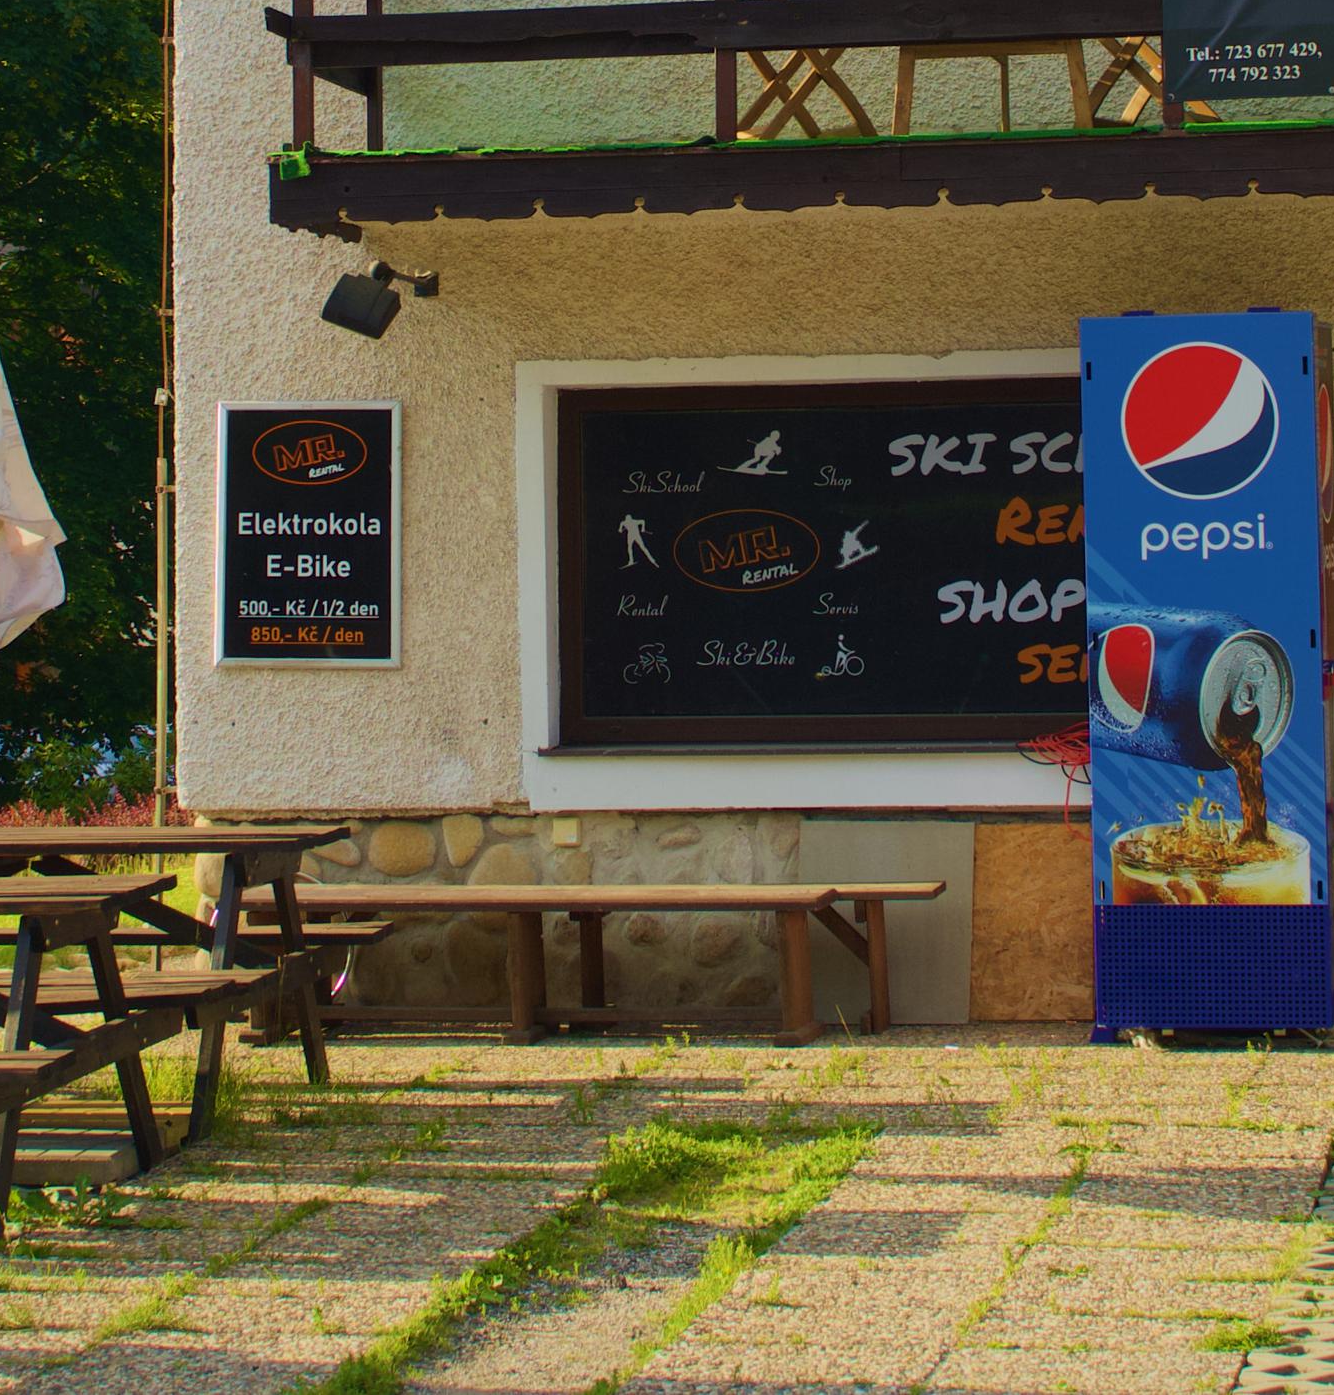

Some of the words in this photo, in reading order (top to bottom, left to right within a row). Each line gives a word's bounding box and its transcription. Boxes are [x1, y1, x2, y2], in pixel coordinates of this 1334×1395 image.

[1185, 47, 1220, 62] Tel.:
[1224, 44, 1252, 60] 723
[1257, 43, 1285, 59] 677
[1289, 41, 1323, 59] 429,
[1208, 67, 1237, 83] 774
[1241, 66, 1268, 82] 792
[1272, 64, 1301, 80] 323
[887, 432, 997, 476] SKI
[308, 463, 346, 479] RENTAL
[813, 465, 853, 491] Shop
[237, 511, 382, 536] Elektrokola
[1140, 512, 1266, 561] pepsi
[266, 554, 352, 577] E-Bike
[742, 563, 799, 585] RENTAL
[285, 599, 306, 616] Kč
[322, 600, 344, 616] 1/2
[349, 600, 379, 616] den
[617, 593, 669, 617] Rental
[812, 592, 860, 616] Servis
[936, 577, 1086, 625] SHOP
[298, 625, 318, 642] Kč
[335, 626, 364, 642] den
